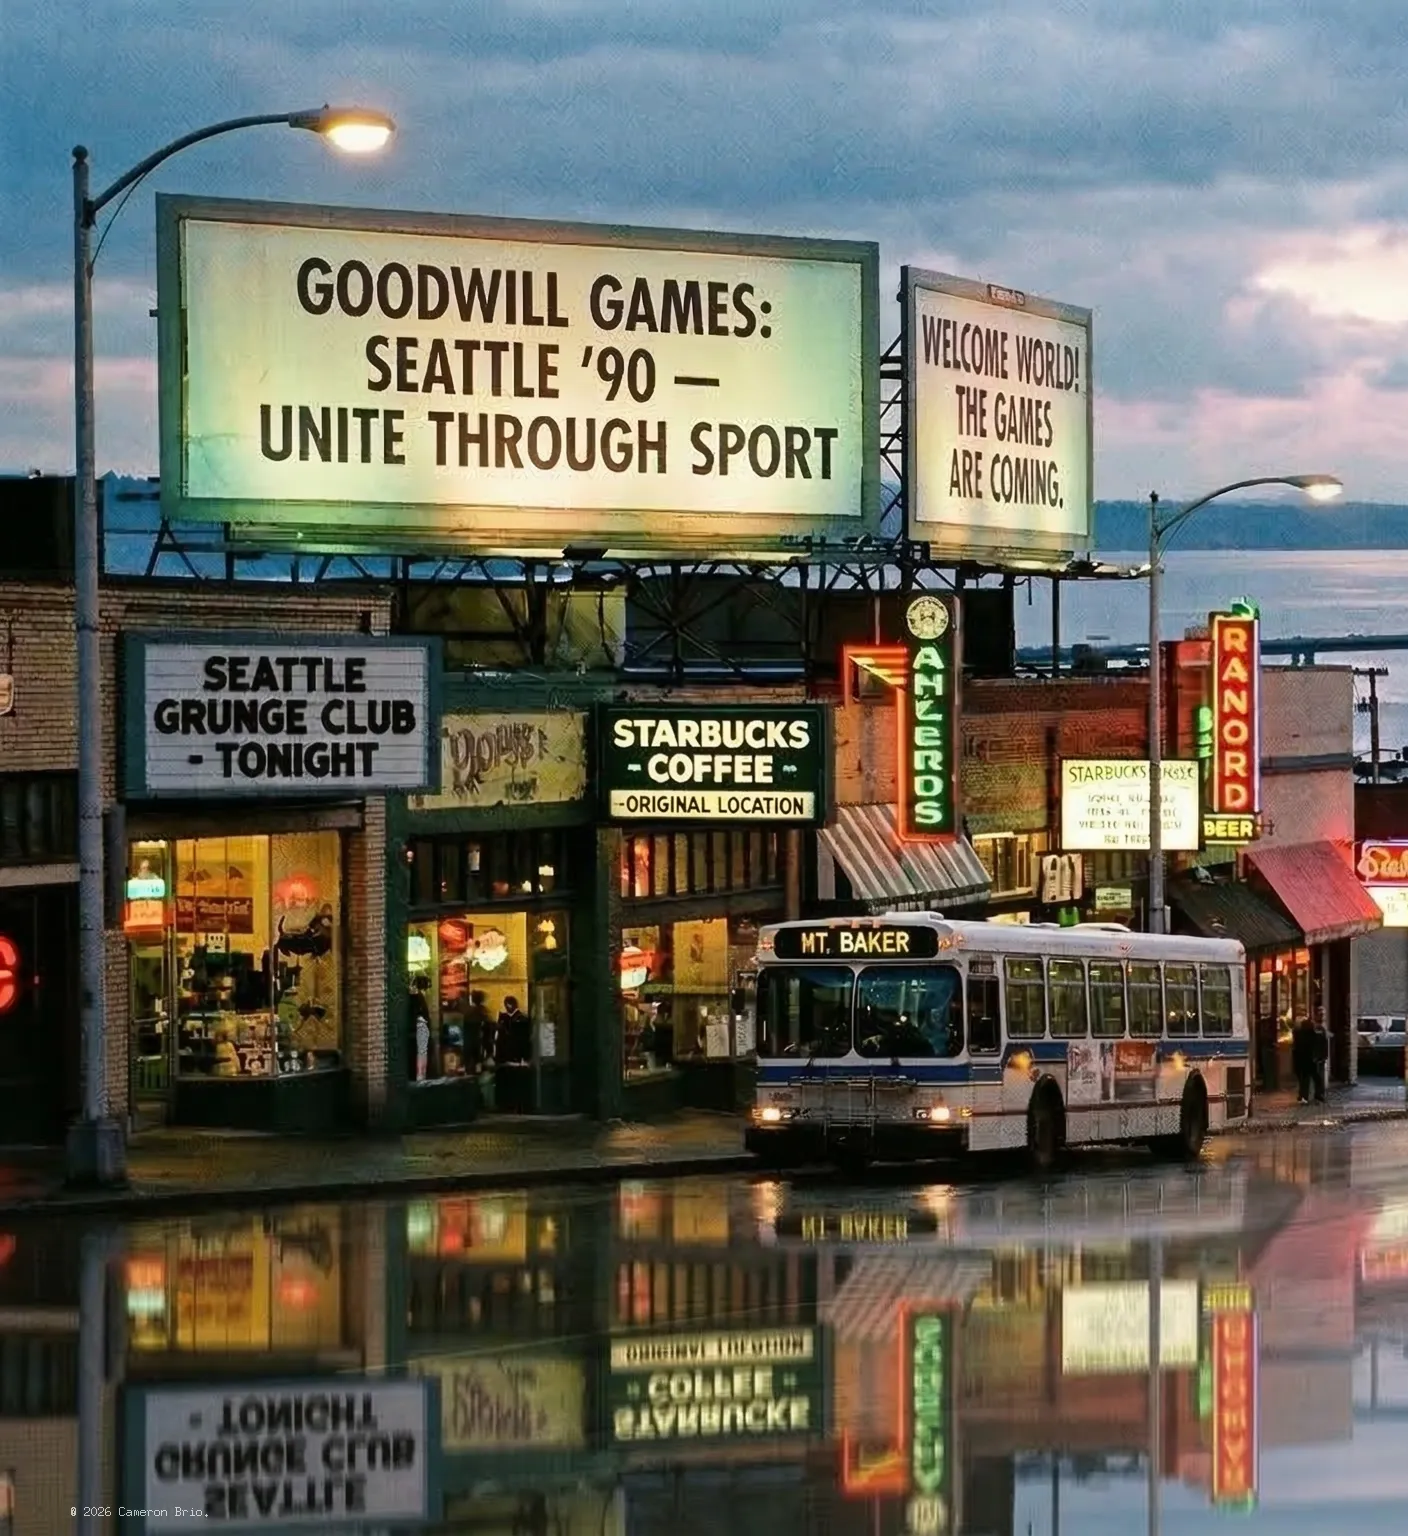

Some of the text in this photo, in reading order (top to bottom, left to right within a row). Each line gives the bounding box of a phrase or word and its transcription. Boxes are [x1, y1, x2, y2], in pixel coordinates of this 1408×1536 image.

[297, 257, 772, 340] GOODWILL GAMES:
[366, 335, 559, 399] SEATTLE
[582, 345, 655, 403] '90
[922, 314, 1080, 393] WELCOME WORLD!
[956, 385, 1053, 448] THE GAMES
[260, 404, 838, 479] UNITE THROUGH SPORT
[949, 449, 1063, 508] ARE COMING.
[203, 656, 366, 693] SEATTLE
[154, 699, 416, 735] GRUNGE CLUB
[614, 719, 809, 748] STARBUCKS
[1222, 627, 1249, 809] RANORD
[215, 742, 379, 778] TONIGHT
[648, 754, 773, 783] COFFEE
[1069, 766, 1146, 782] STARBUCKS
[718, 797, 803, 815] LOCATION
[1203, 820, 1253, 838] BEER
[840, 932, 909, 952] BAKER
